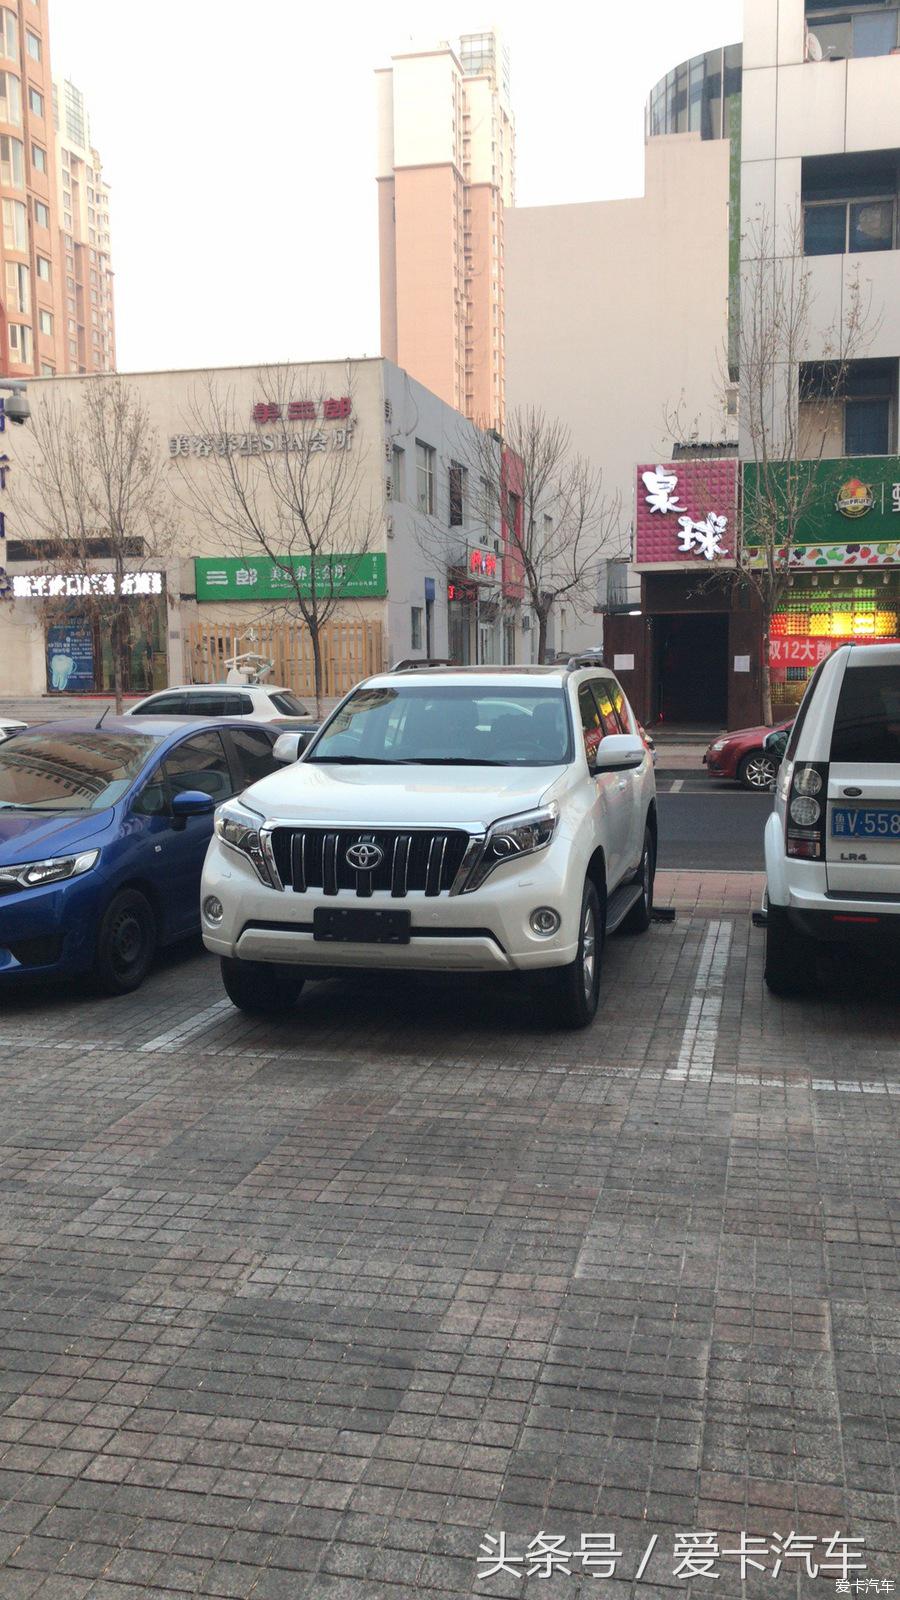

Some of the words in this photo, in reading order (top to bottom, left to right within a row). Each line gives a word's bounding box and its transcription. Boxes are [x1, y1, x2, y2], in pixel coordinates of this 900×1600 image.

[642, 464, 729, 560] 桌球
[206, 568, 258, 586] 三郎
[840, 853, 867, 861] LR4
